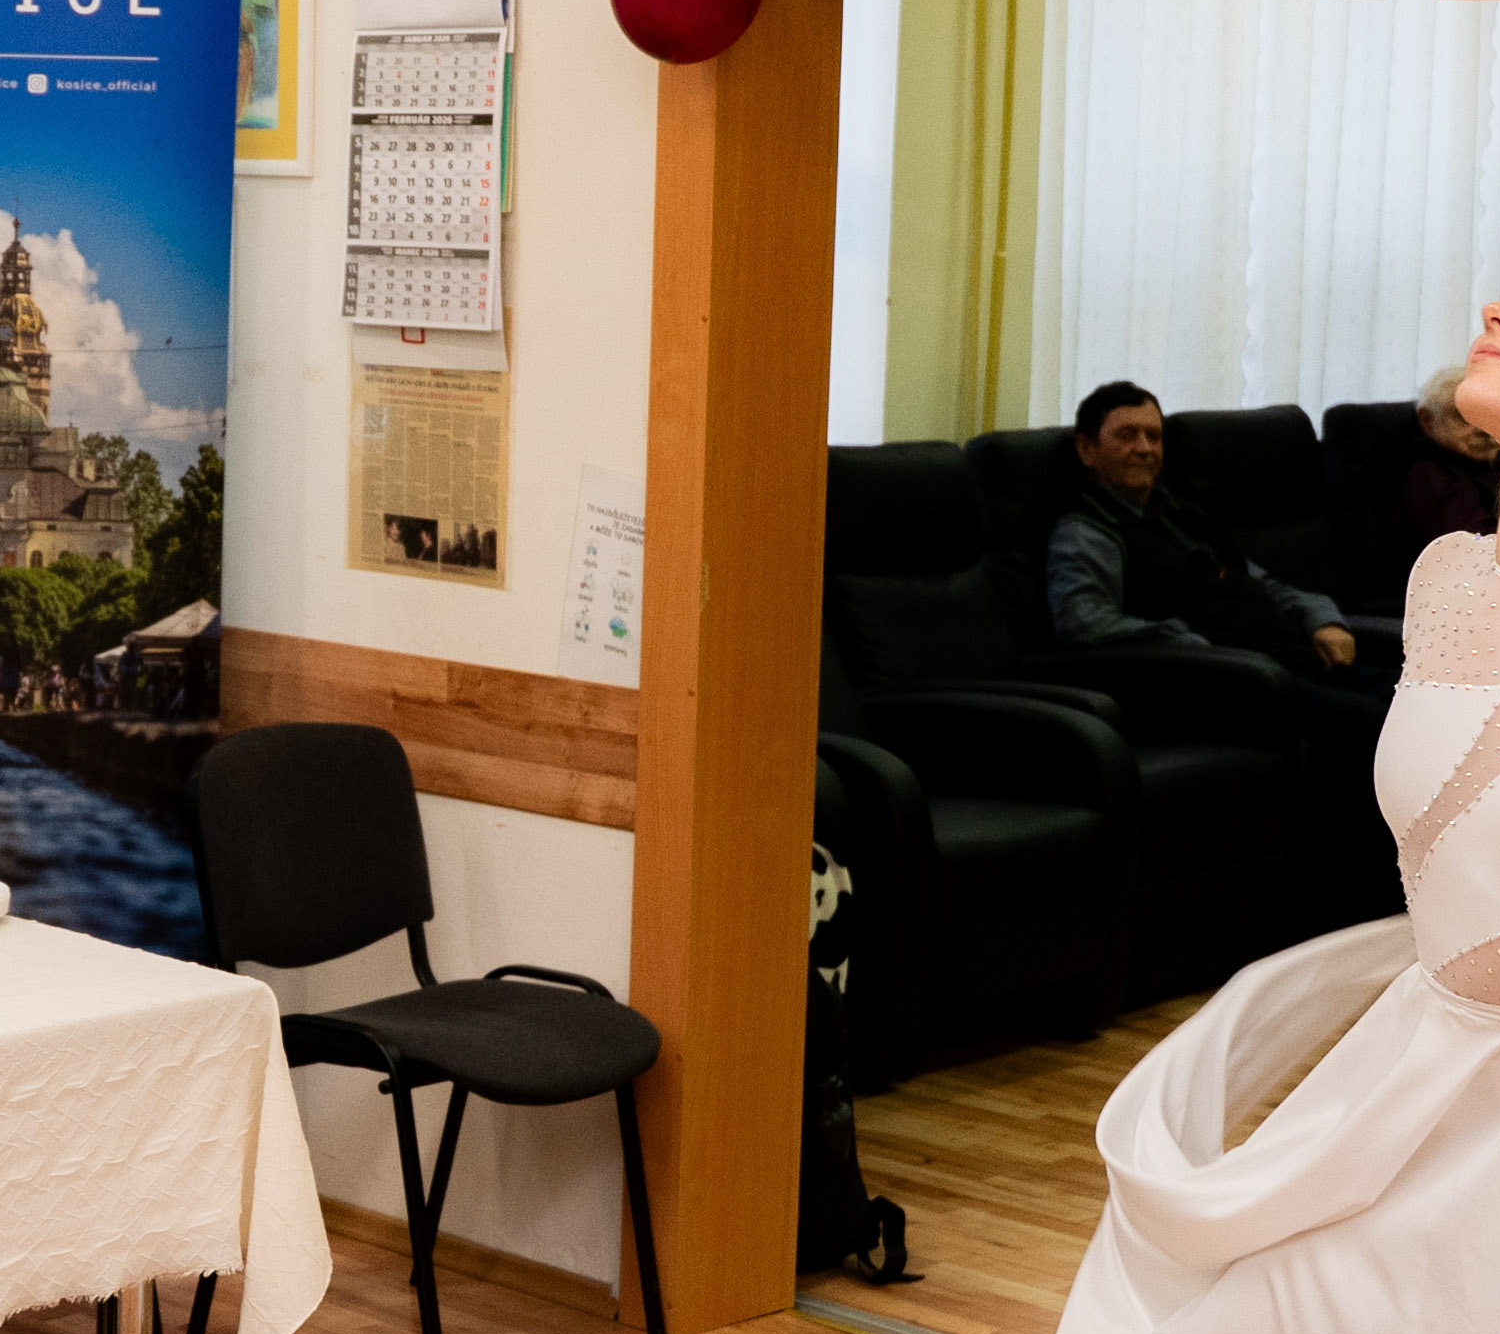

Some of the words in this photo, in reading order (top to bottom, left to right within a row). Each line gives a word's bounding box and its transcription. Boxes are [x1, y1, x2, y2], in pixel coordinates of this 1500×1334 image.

[56, 78, 158, 93] kosice_official
[390, 114, 429, 124] FEBRUÁR
[370, 142, 379, 151] 26
[388, 142, 397, 151] 27
[406, 142, 416, 151] 28
[425, 142, 435, 151] 29
[443, 143, 453, 152] 30
[462, 143, 472, 152] 31
[388, 178, 397, 186] 10
[407, 178, 415, 186] 11
[425, 178, 433, 187] 12
[444, 178, 452, 187] 13
[462, 179, 470, 187] 14
[481, 179, 490, 188] 15
[370, 195, 378, 203] 16
[388, 195, 396, 204] 17
[407, 196, 415, 204] 18
[425, 196, 433, 205] 19
[442, 196, 451, 205] 20
[461, 196, 469, 205] 21
[479, 197, 489, 206] 22
[368, 212, 377, 221] 23
[386, 212, 395, 221] 24
[405, 213, 414, 222] 25
[423, 213, 433, 223] 26
[441, 214, 451, 223] 27
[460, 214, 470, 223] 28
